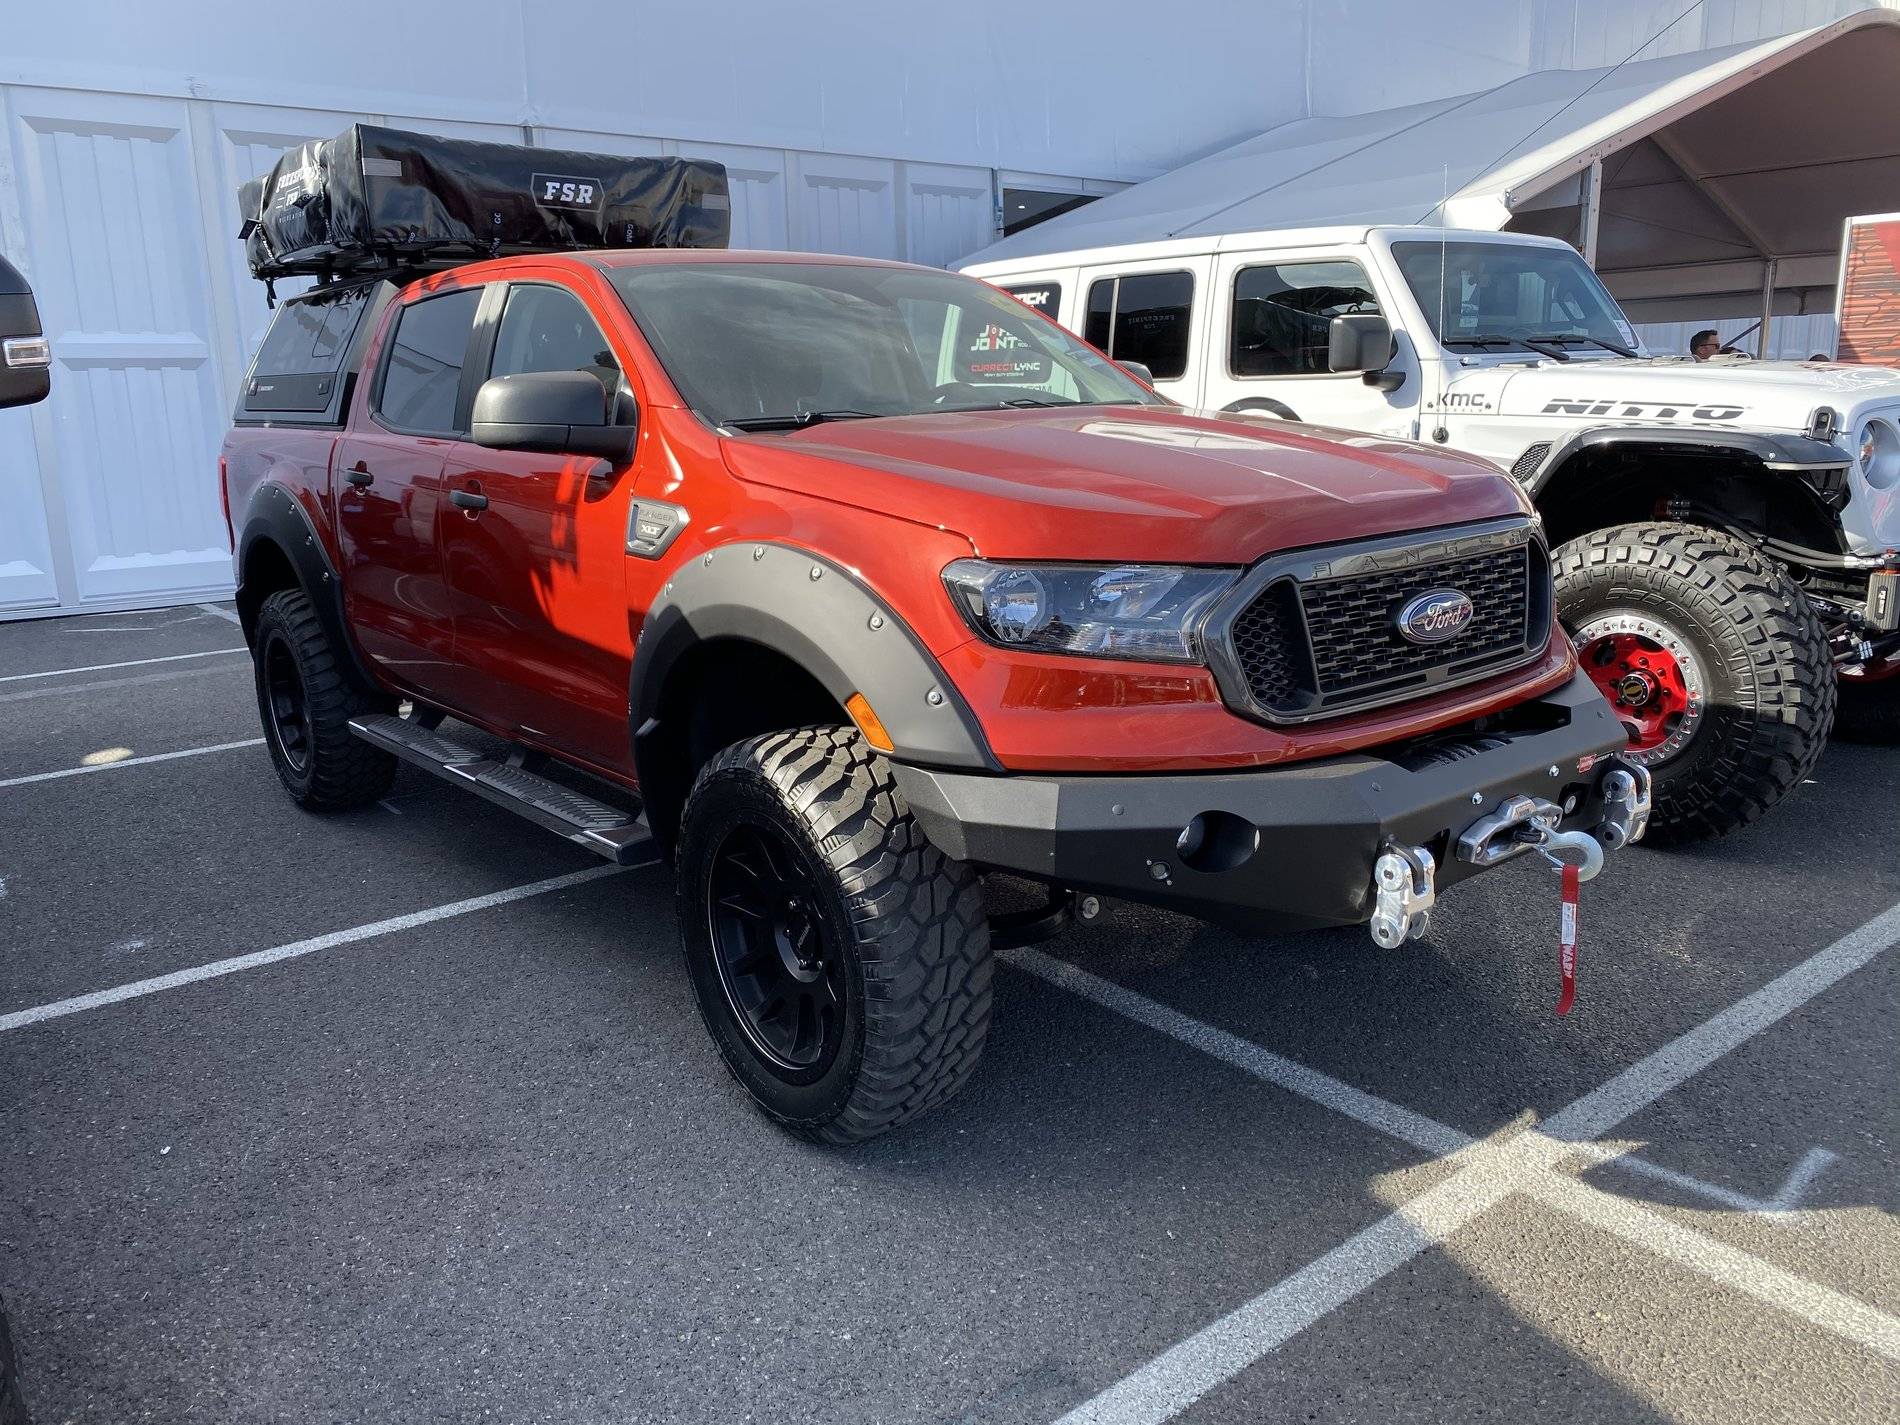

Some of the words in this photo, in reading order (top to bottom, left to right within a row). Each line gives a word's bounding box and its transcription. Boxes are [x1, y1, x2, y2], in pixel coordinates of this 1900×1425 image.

[544, 181, 594, 204] FSR
[1541, 398, 1745, 420] NITTO
[1424, 600, 1463, 631] Ford
